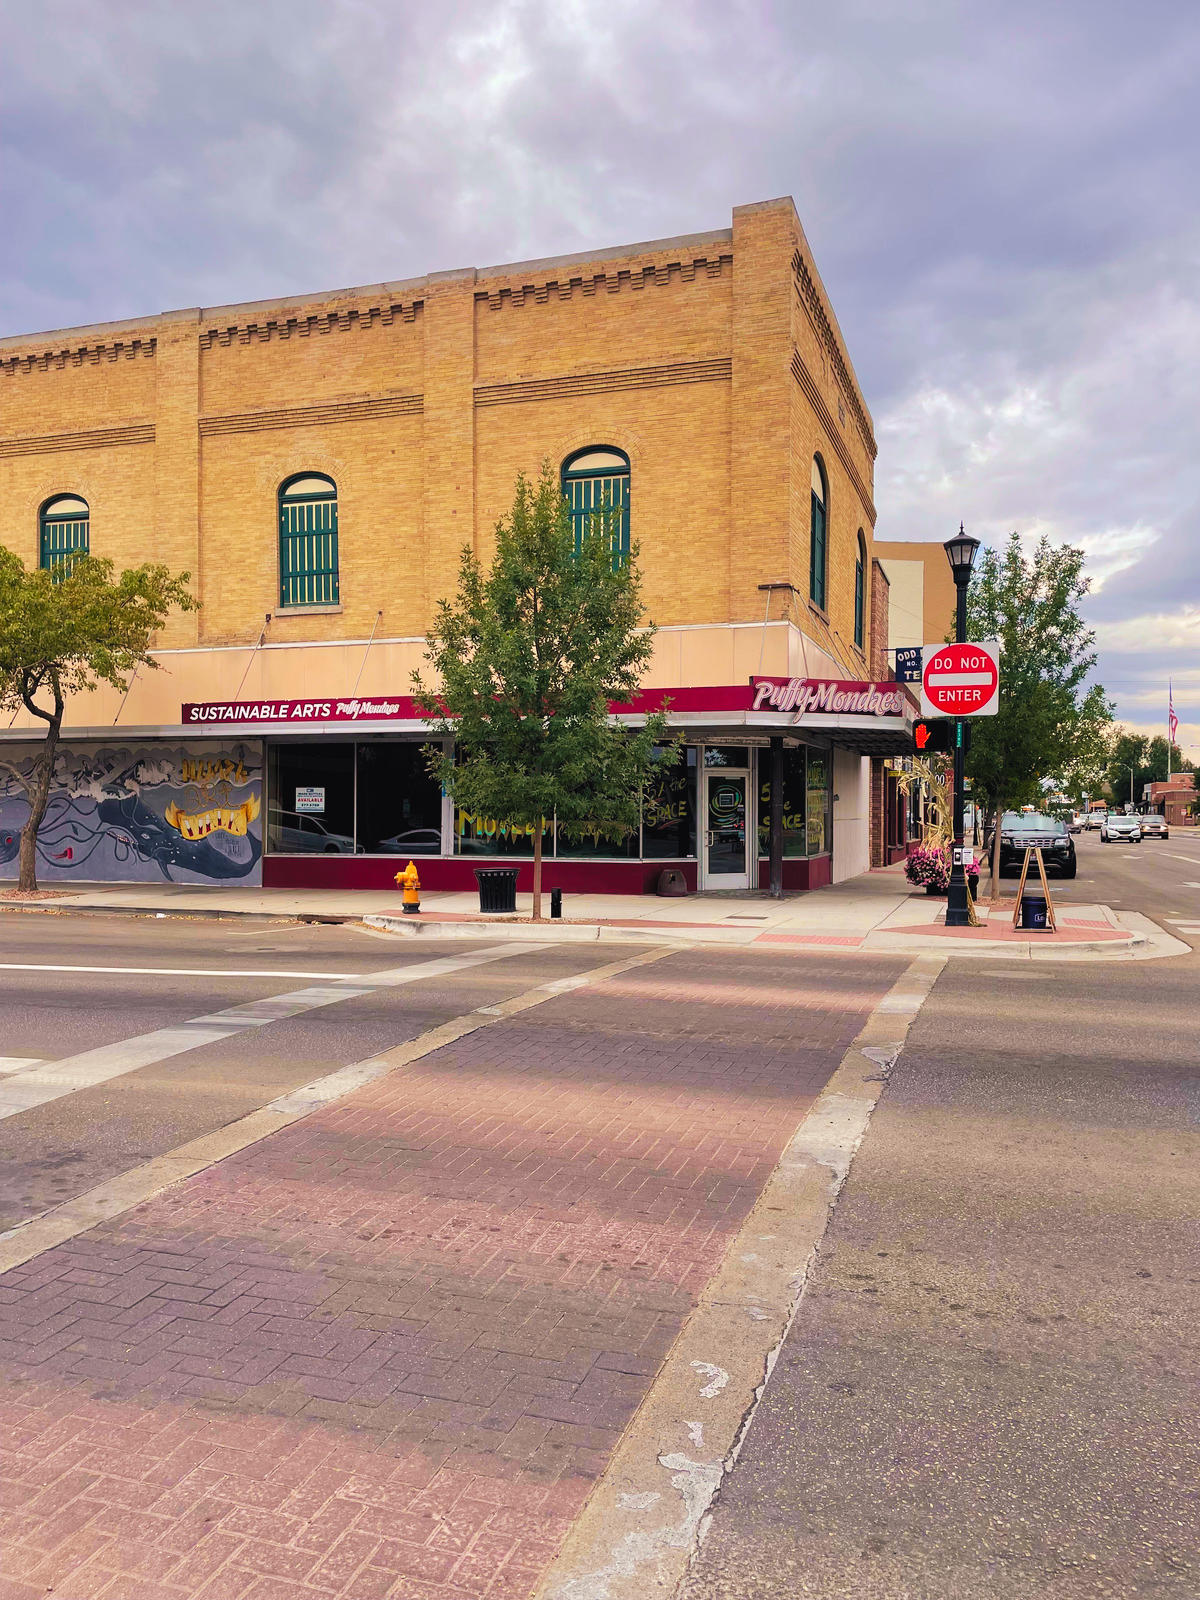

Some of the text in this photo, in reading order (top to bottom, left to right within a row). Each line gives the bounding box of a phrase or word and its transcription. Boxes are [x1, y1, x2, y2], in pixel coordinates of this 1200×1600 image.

[897, 649, 916, 662] ODD
[934, 656, 987, 670] DO NOT
[752, 677, 814, 724] Puffy
[938, 690, 981, 702] ENTER
[190, 704, 289, 721] SUSTAINABLE
[290, 703, 331, 719] ARTS
[335, 700, 361, 719] Puffy
